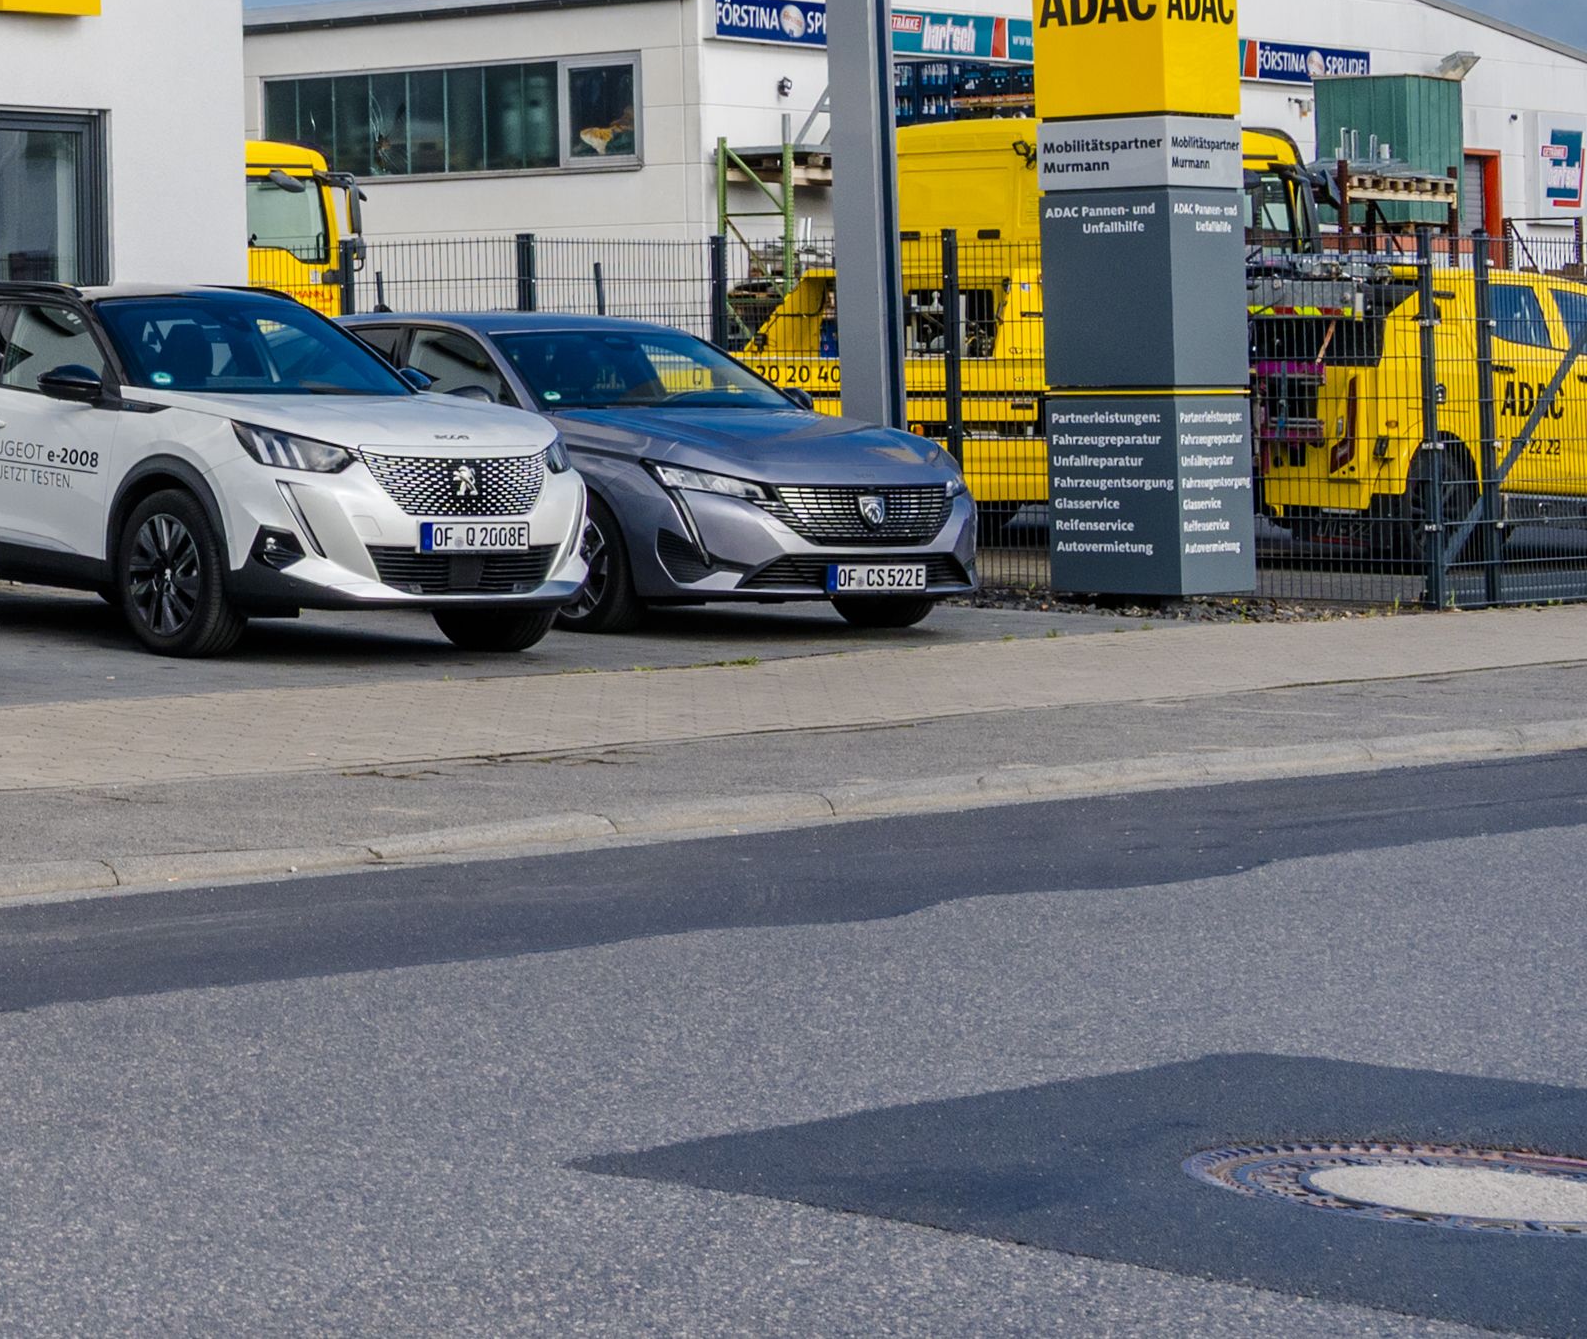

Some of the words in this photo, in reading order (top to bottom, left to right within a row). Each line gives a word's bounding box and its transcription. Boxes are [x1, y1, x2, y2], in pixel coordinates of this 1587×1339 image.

[892, 15, 920, 31] TRÄNKE
[922, 16, 976, 54] bartsch
[1259, 46, 1307, 73] FÖRSTINA
[1043, 137, 1163, 155] Mobilitätspartner
[1171, 136, 1240, 152] Mobilitätspartner
[1043, 161, 1110, 174] Murmann
[1171, 156, 1211, 170] Murmann
[1045, 206, 1079, 219] ADAC
[1081, 204, 1130, 217] Pannen-
[1132, 202, 1156, 216] und
[1174, 202, 1194, 215] ADAC
[1083, 221, 1145, 234] Unfallhilfe
[787, 365, 810, 383] 20
[818, 365, 840, 383] 40
[1052, 412, 1161, 426] Partnerleistungen:
[1052, 434, 1161, 448] Fahrzeugreparatur
[47, 448, 99, 468] e-2008
[1053, 456, 1144, 469] Unfallreparatur
[0, 465, 28, 483] JETZT
[30, 469, 73, 489] TESTEN.
[1054, 477, 1174, 491] Fahrzeugentsorgung
[1055, 498, 1121, 509] Glasservice
[1056, 519, 1135, 531] Reifenservice
[434, 527, 453, 546] OF
[467, 527, 475, 546] Q
[480, 527, 526, 546] 2008E
[1057, 541, 1154, 556] Autovermietung
[838, 569, 857, 587] OF
[867, 569, 885, 587] CS
[888, 568, 924, 587] 522E
